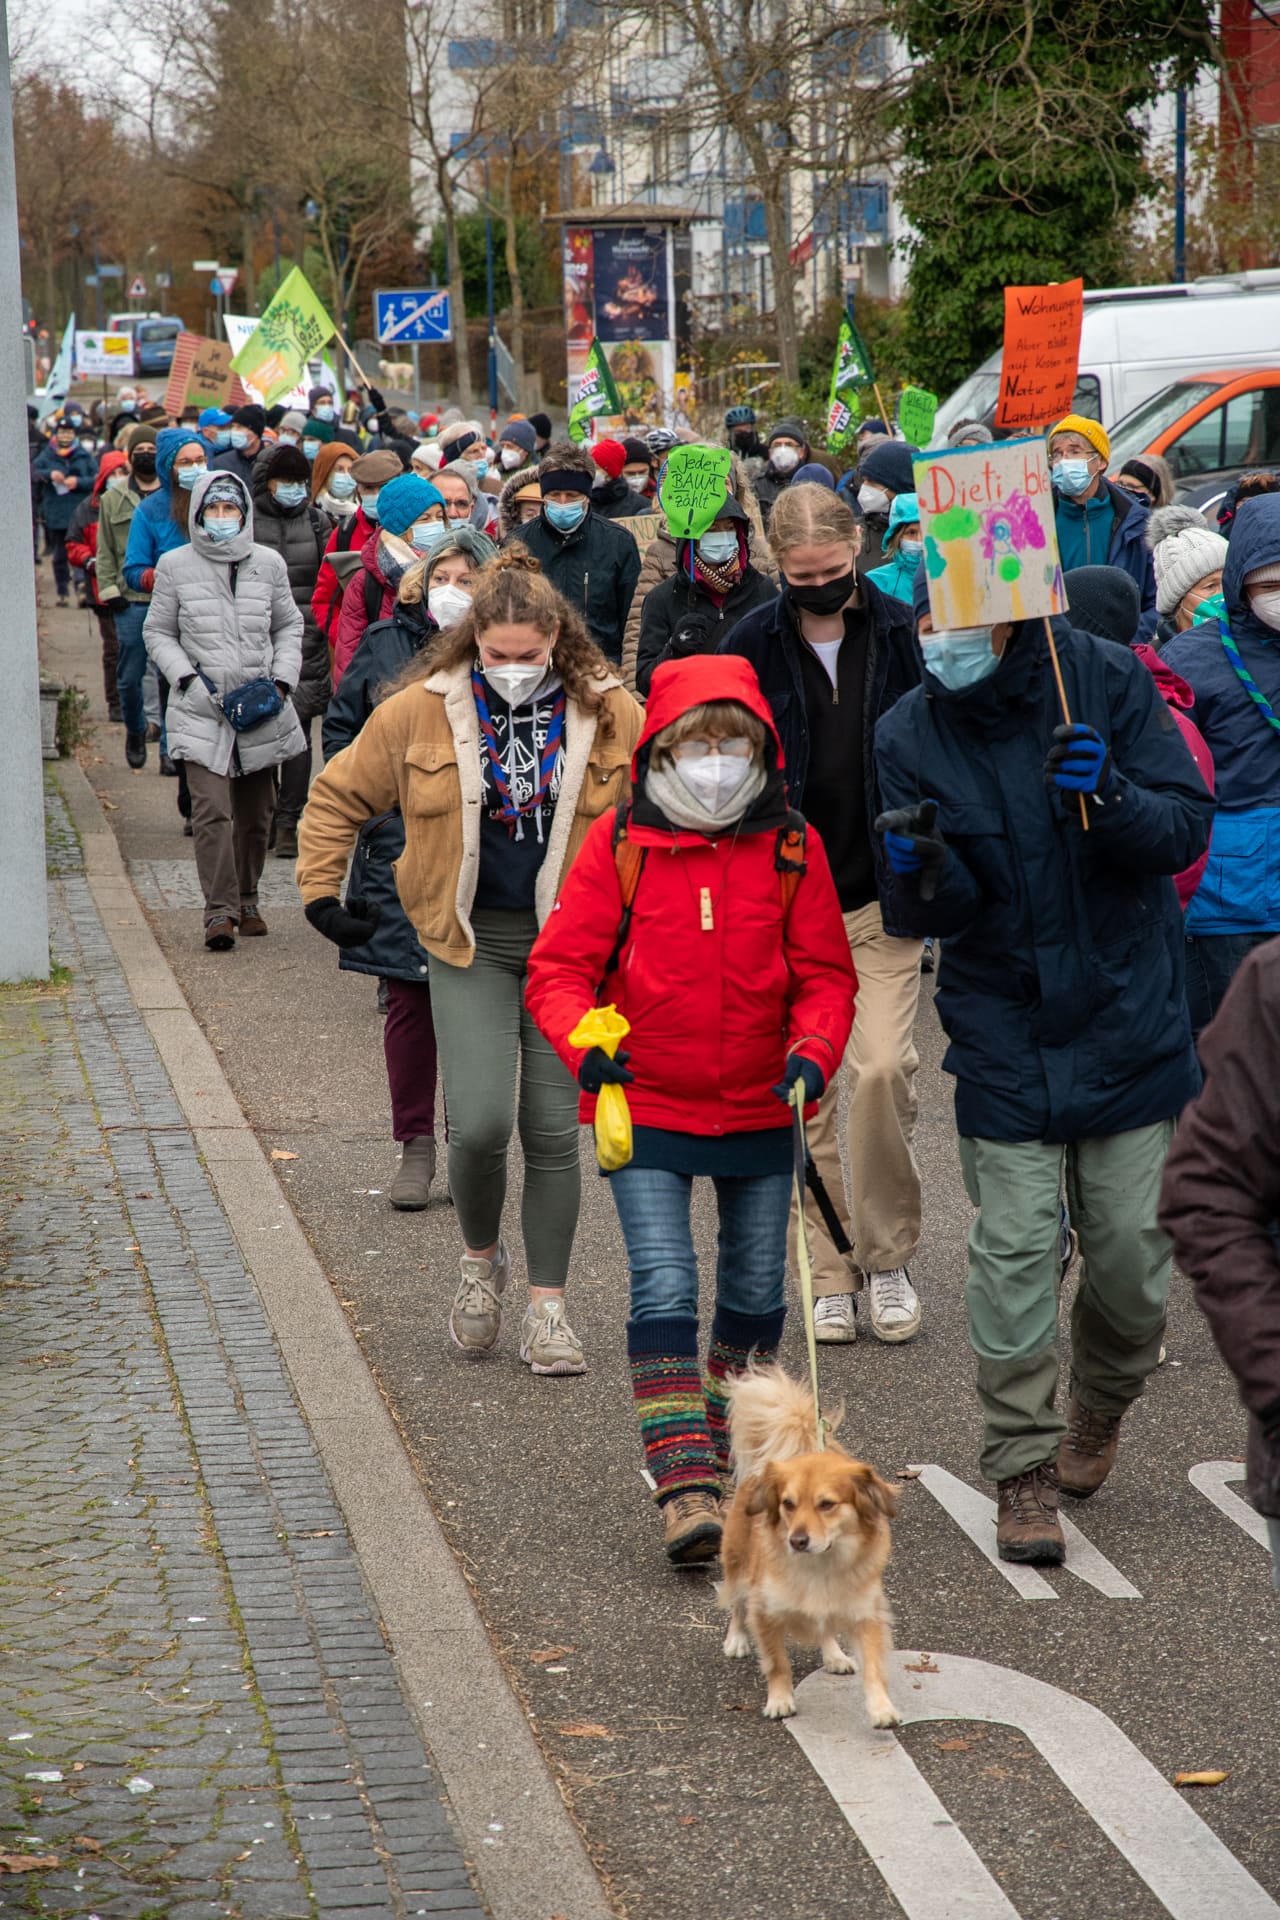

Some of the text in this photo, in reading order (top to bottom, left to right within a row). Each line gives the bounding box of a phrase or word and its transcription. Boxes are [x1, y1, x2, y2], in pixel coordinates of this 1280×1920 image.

[1005, 374, 1047, 397] Natur
[676, 453, 721, 475] Jeder
[671, 472, 718, 493] BAUM
[928, 461, 1003, 514] Dieti
